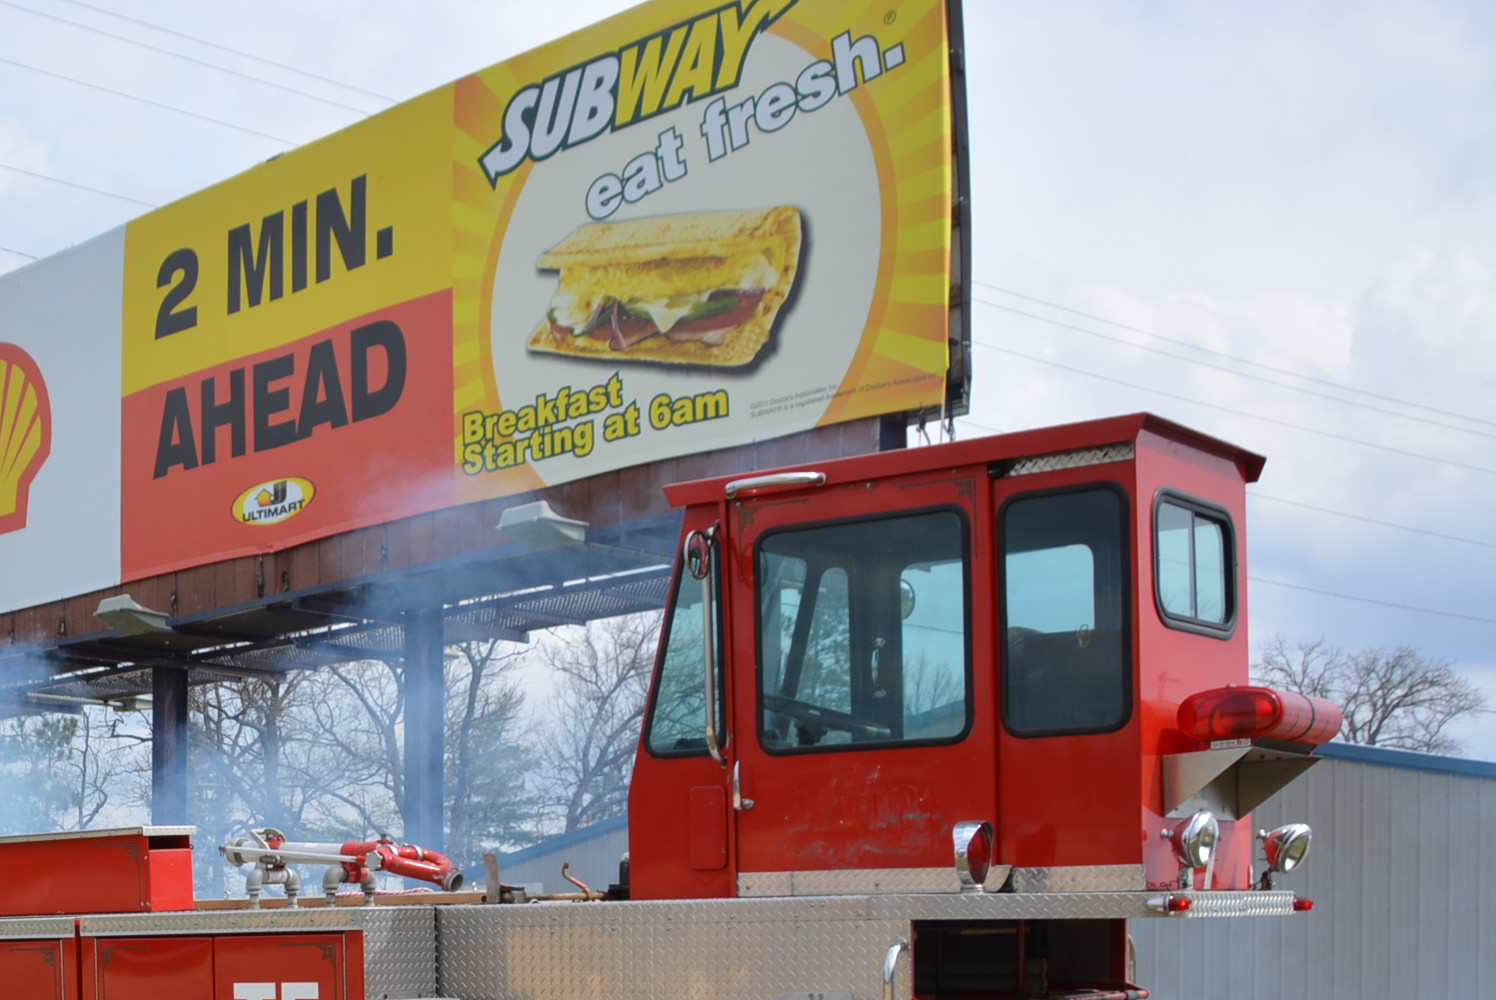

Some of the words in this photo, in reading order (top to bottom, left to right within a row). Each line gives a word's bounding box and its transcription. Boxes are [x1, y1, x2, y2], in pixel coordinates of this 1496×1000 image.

[477, 0, 801, 190] SUBWAY
[585, 126, 688, 221] eat
[700, 29, 906, 163] fresh.
[155, 247, 199, 341] 2
[227, 173, 394, 316] MIN.
[153, 319, 408, 480] AHEAD
[461, 370, 624, 446] Breakfast
[461, 420, 594, 475] Starting
[603, 403, 641, 444] at
[649, 388, 730, 430] 6am
[242, 498, 306, 522] ULTIMART
